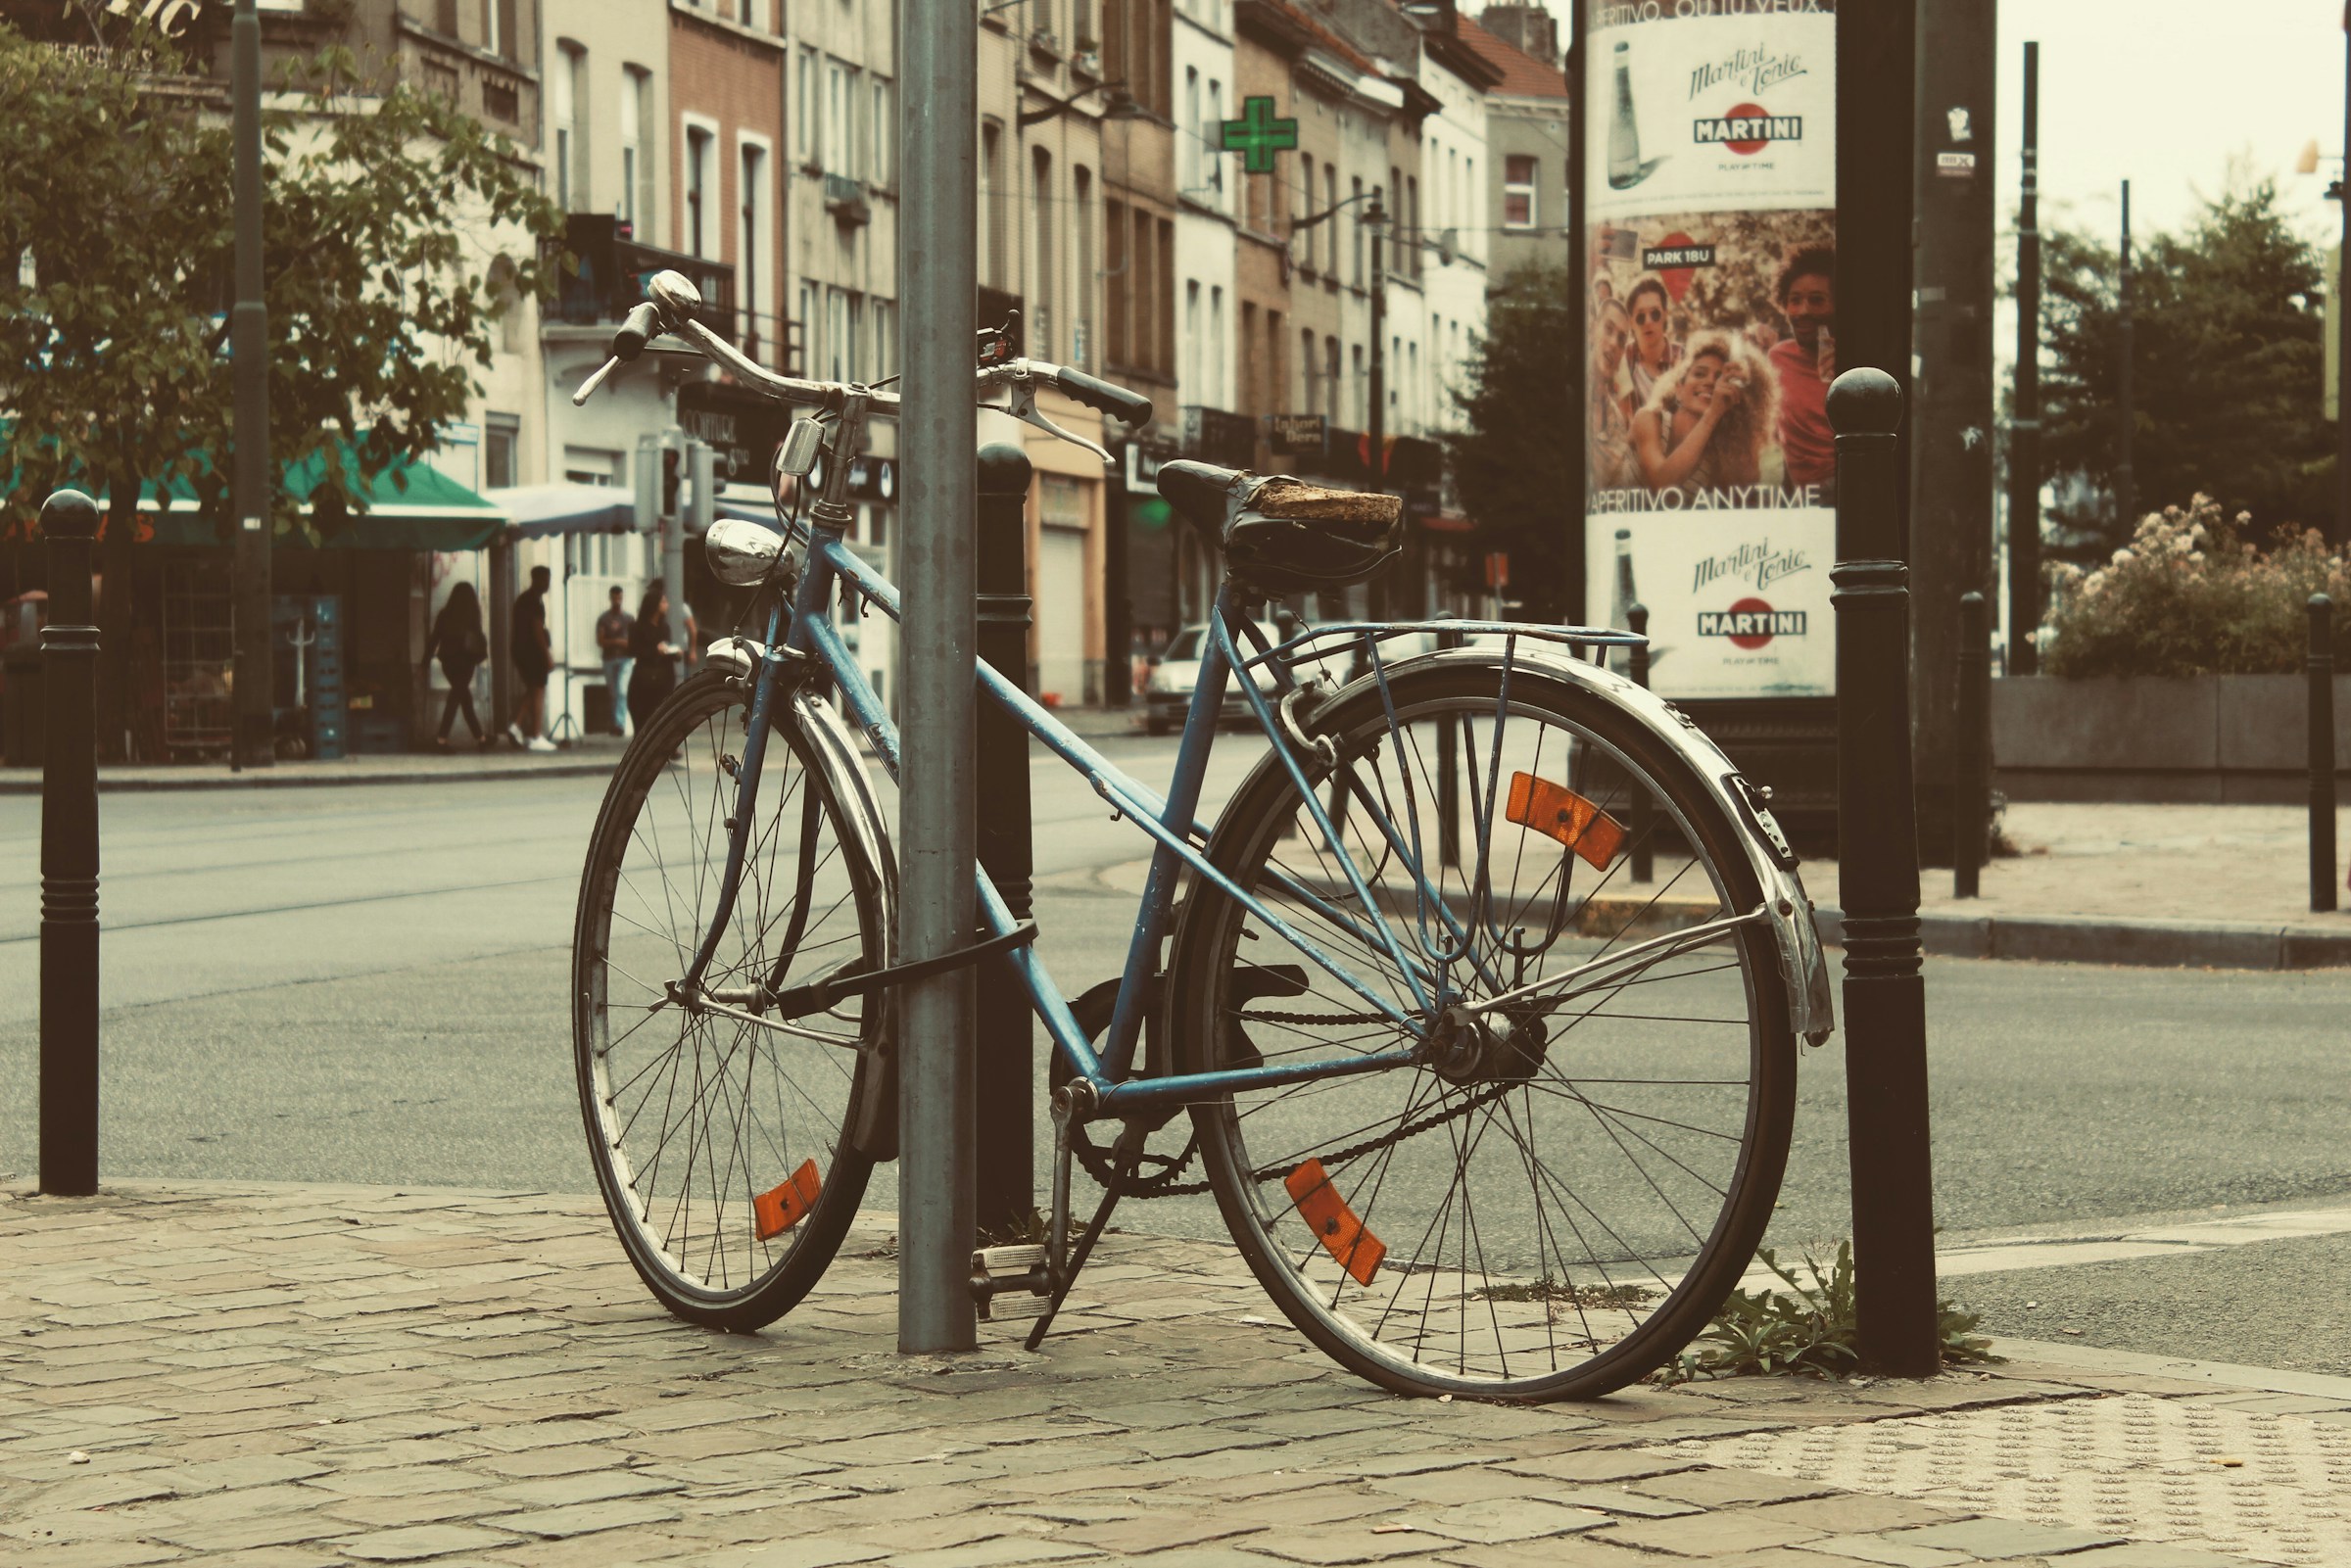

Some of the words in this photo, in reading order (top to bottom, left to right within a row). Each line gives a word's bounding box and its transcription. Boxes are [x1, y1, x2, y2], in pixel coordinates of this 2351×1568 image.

[1676, 0, 1711, 18] OU
[1690, 42, 1765, 101] Martini
[1750, 54, 1807, 96] Tonic
[1697, 119, 1799, 141] MARTINI
[1717, 163, 1740, 171] PLAY
[1752, 162, 1775, 170] TIME
[1647, 251, 1682, 264] PARK
[1591, 487, 1683, 515] APERITIVO
[1693, 485, 1818, 510] ANYTIME
[1693, 537, 1768, 594] Martini
[1752, 549, 1811, 591] Tonic
[1701, 613, 1803, 635] MARTINI
[1722, 657, 1745, 666] PLAY
[1758, 657, 1780, 666] TIME
